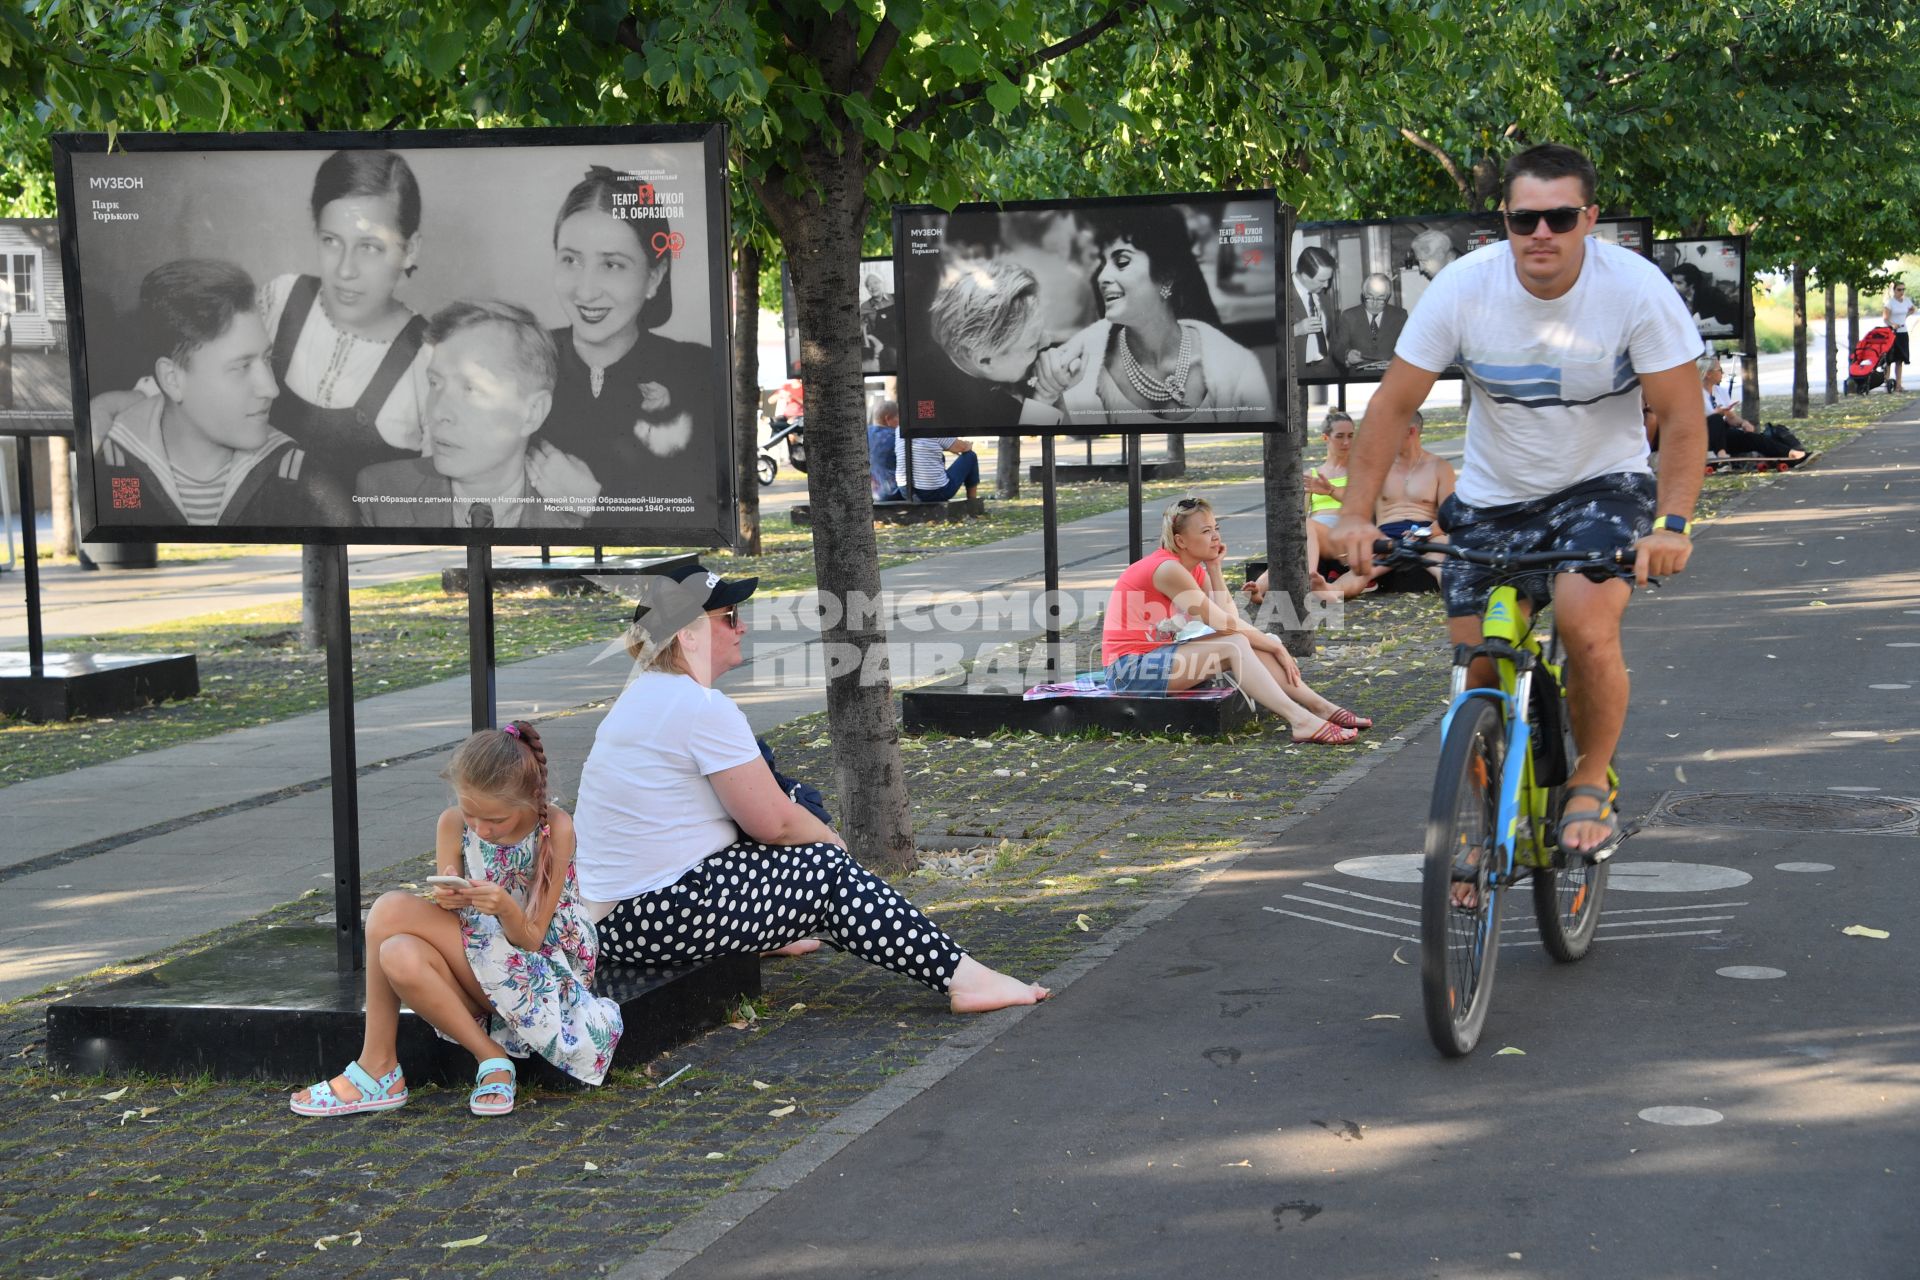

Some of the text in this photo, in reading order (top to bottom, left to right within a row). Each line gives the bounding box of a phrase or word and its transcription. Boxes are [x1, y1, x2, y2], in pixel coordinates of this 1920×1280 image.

[90, 177, 144, 189] МУЗЕОН
[612, 192, 684, 205] ТЕАТР КУКОЛ
[92, 200, 120, 212] Парк
[93, 211, 139, 223] Горького
[612, 206, 684, 219] С.В. ОБРАЗЦОВА
[911, 229, 943, 237] МУЗЕОН
[912, 242, 928, 250] Парк
[352, 495, 379, 505] Сергей
[380, 495, 417, 505] Образцов
[453, 496, 490, 504] Алексеем
[498, 496, 535, 504] Наталией
[543, 496, 568, 504] женой
[569, 496, 597, 504] Ольгой
[598, 496, 695, 505] Образцовой-Шагановой.
[544, 504, 575, 513] Москва,
[577, 506, 605, 514] первая
[645, 505, 671, 513] 1940-х
[672, 506, 695, 514] годов
